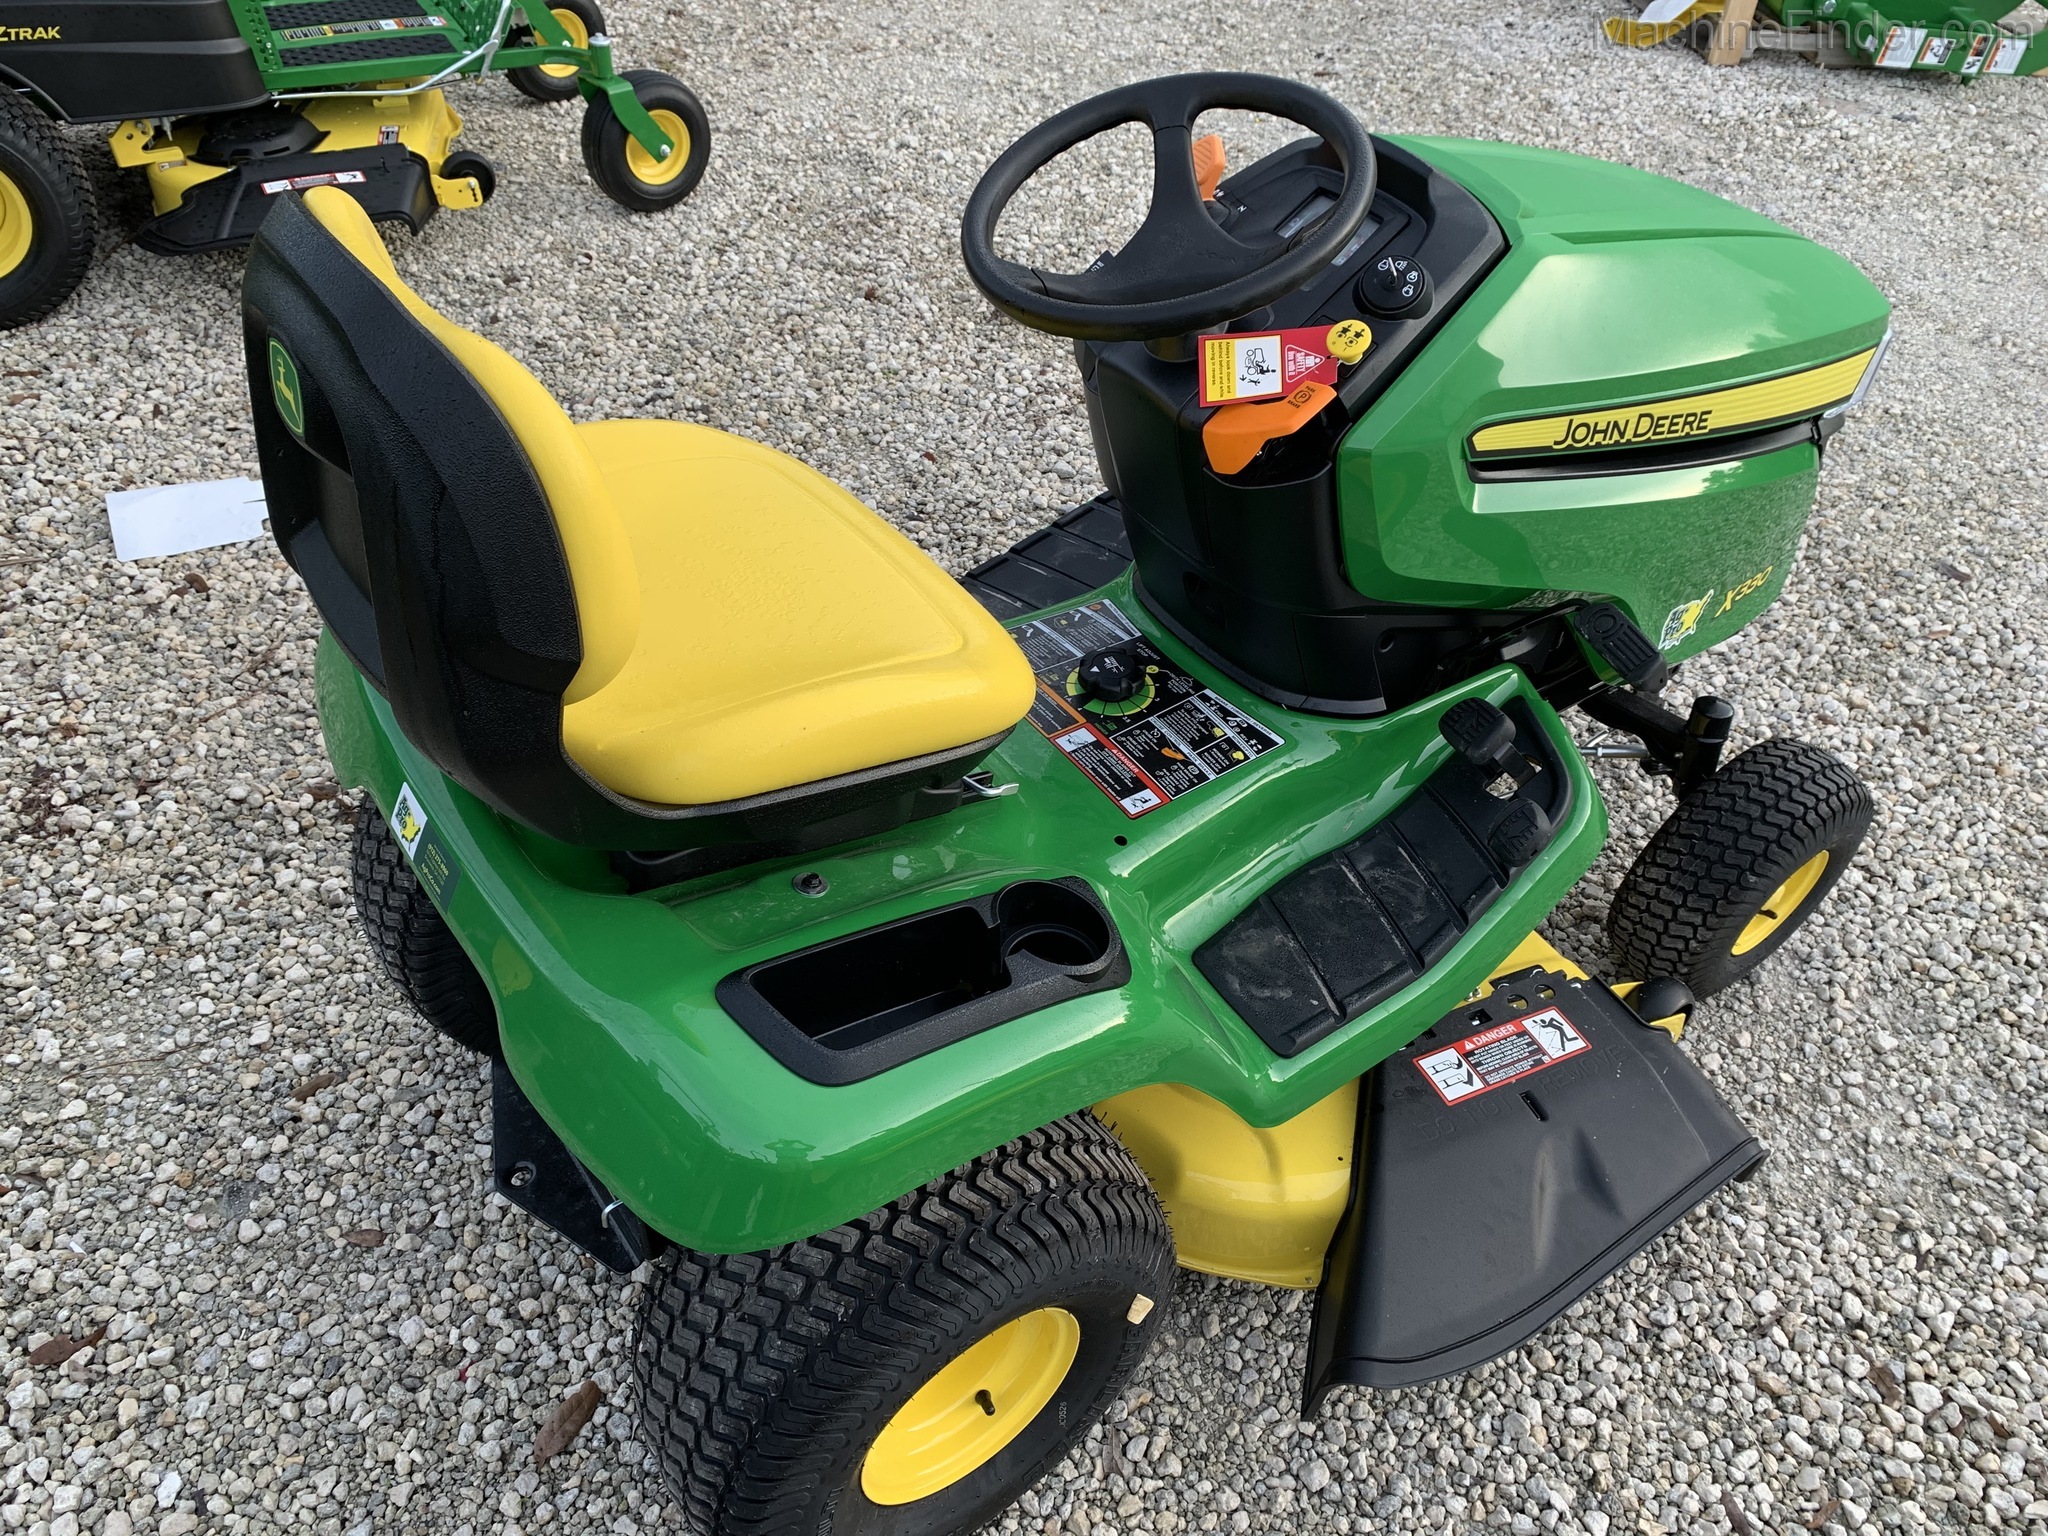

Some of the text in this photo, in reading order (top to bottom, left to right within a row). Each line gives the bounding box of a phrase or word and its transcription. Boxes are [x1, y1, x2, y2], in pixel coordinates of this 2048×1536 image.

[1296, 352, 1305, 372] SAFETY
[1305, 385, 1316, 393] PARK
[1287, 399, 1301, 408] BRAKE
[1553, 409, 1713, 449] JOHN DEERE
[1714, 565, 1773, 618] X330
[1115, 752, 1139, 772] DANGER
[1473, 1024, 1517, 1045] DANGER
[1473, 1034, 1518, 1054] ROTATING BLADE
[1481, 1044, 1528, 1064] THROWN OBJECTS
